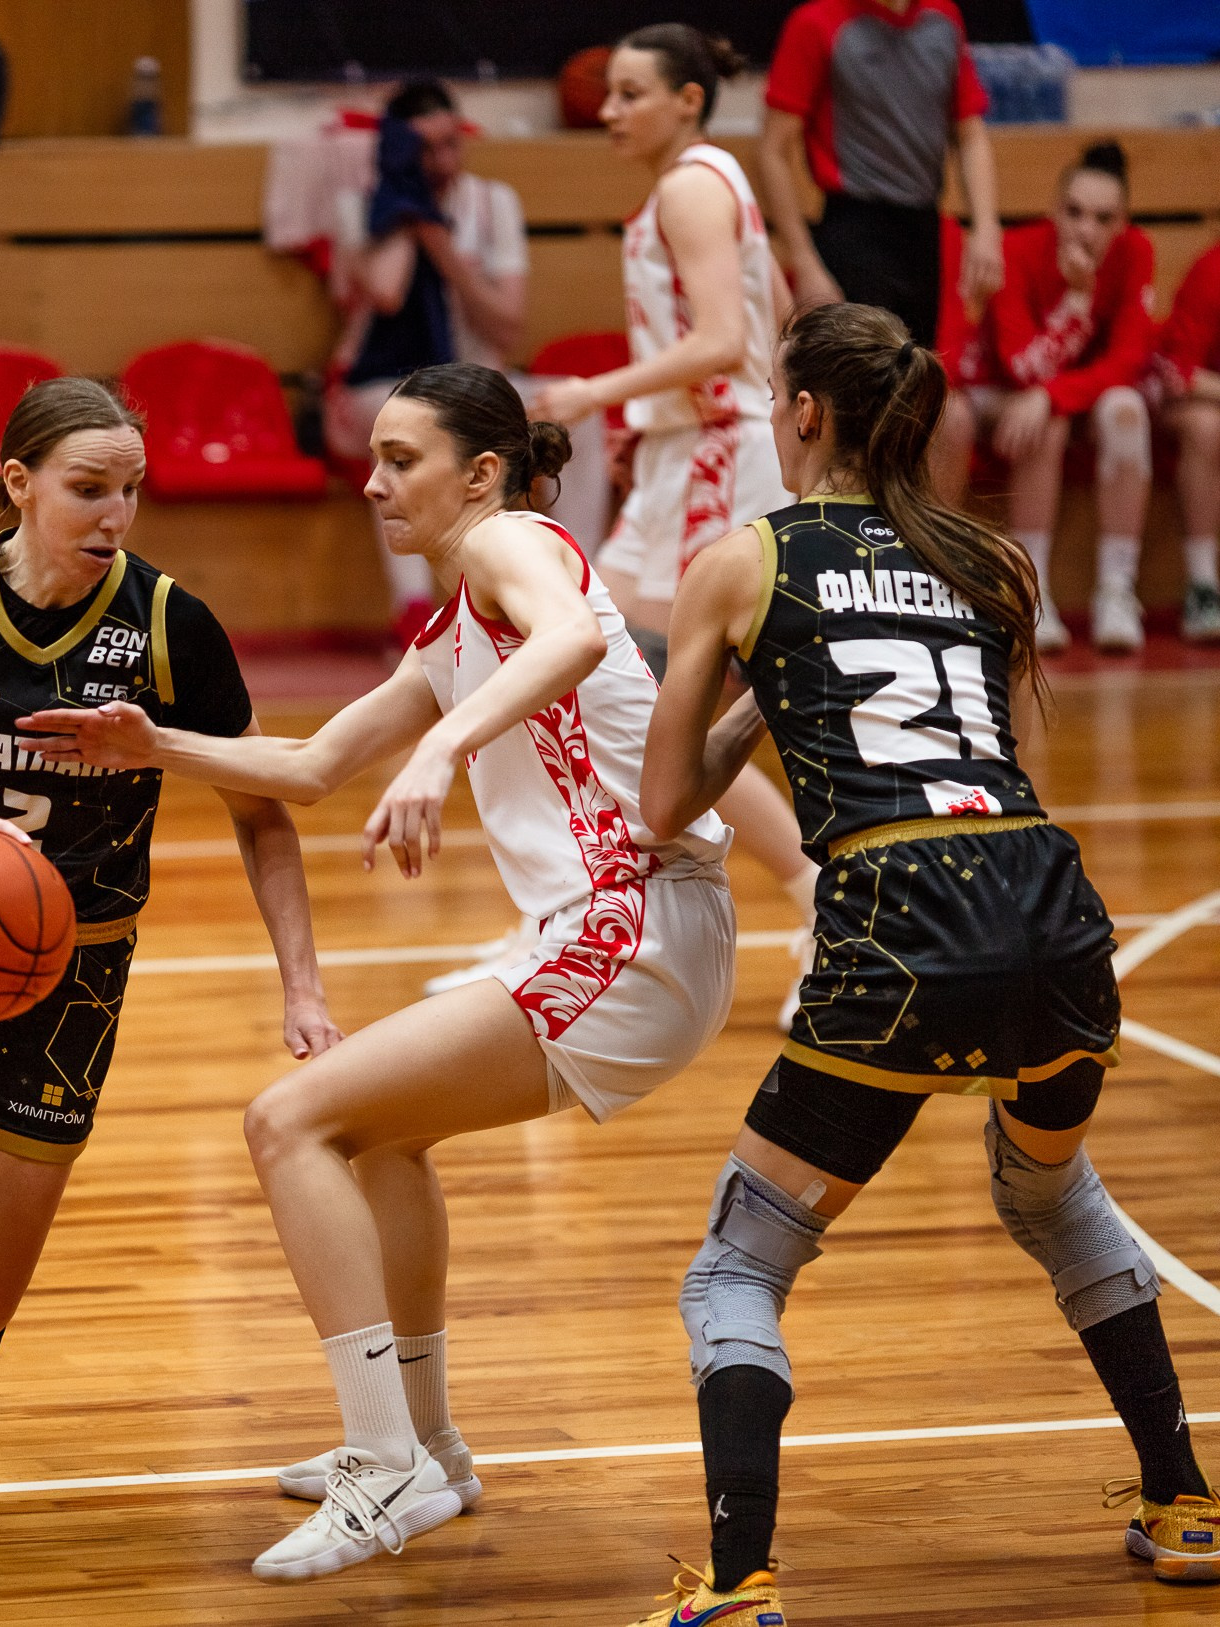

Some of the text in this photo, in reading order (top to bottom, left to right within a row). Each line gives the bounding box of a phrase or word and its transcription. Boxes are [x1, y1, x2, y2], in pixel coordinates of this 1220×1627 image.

[864, 526, 895, 537] РФБ
[95, 626, 148, 651] FON
[87, 645, 141, 669] BET
[827, 638, 1009, 768] 21
[7, 1100, 85, 1124] ХИМПРОМ
